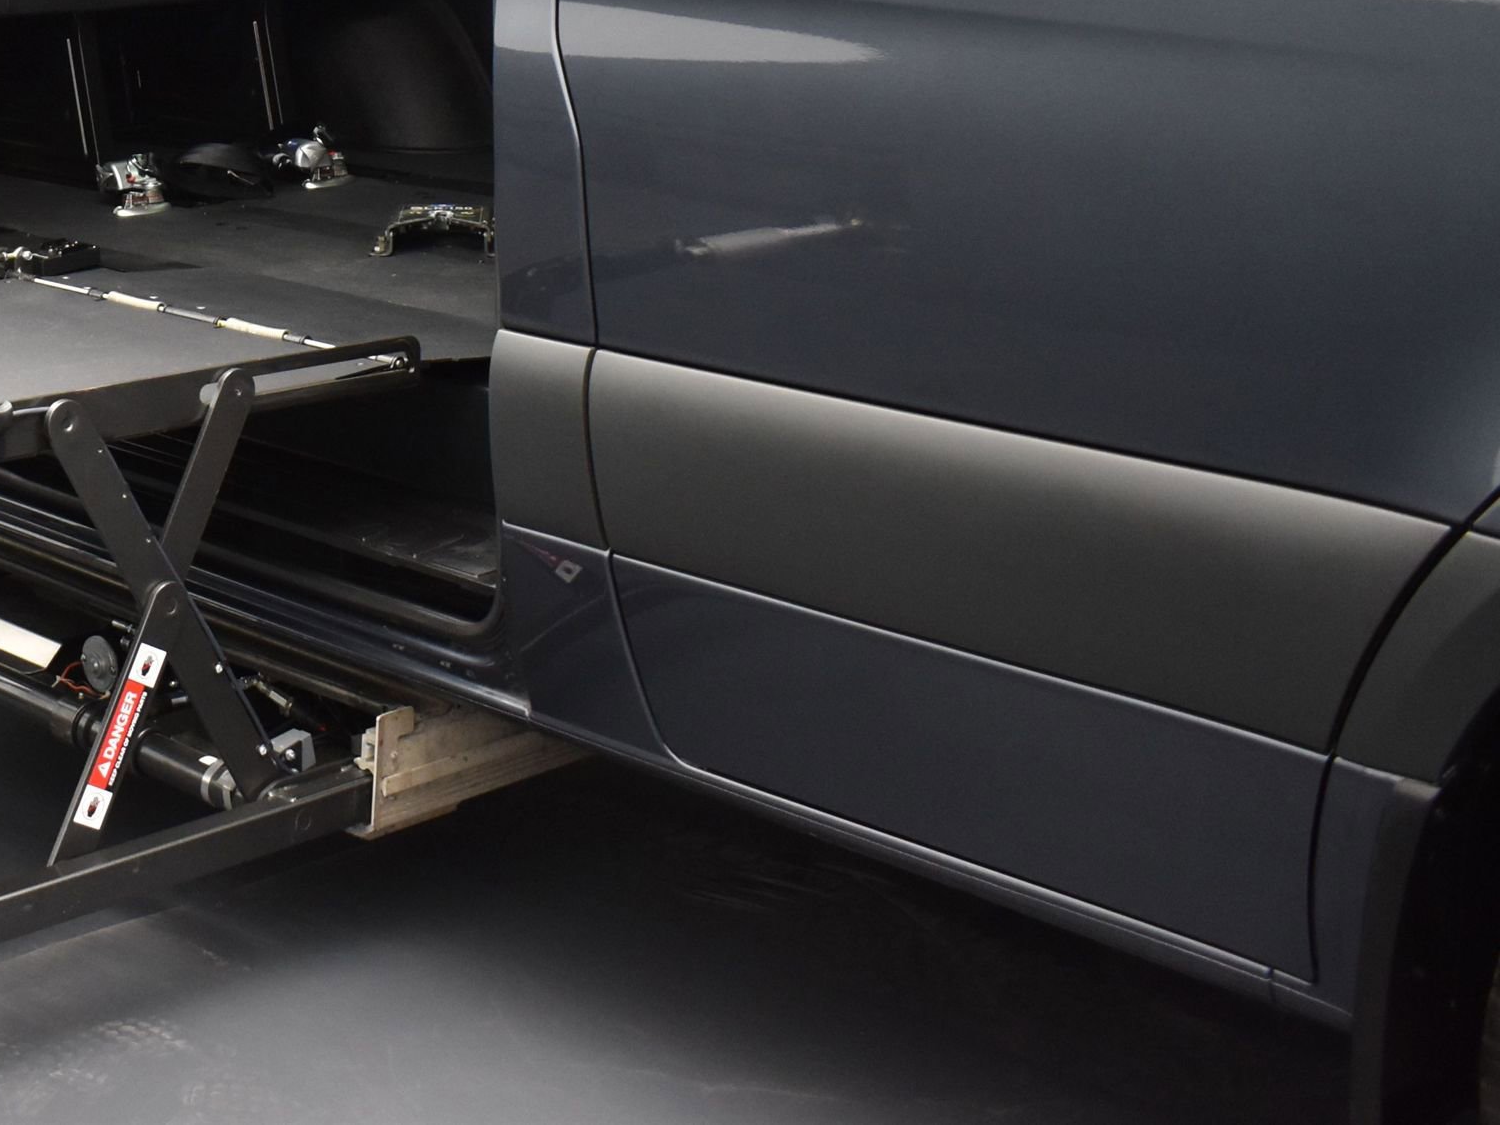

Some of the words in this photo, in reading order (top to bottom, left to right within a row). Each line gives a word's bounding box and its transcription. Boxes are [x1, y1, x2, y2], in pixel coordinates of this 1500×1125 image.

[136, 691, 148, 712] PARTS
[103, 691, 137, 760] DANGER
[126, 712, 140, 738] MOVING
[123, 737, 130, 747] OF
[114, 746, 126, 769] CLEAR
[108, 768, 118, 786] KEEP
